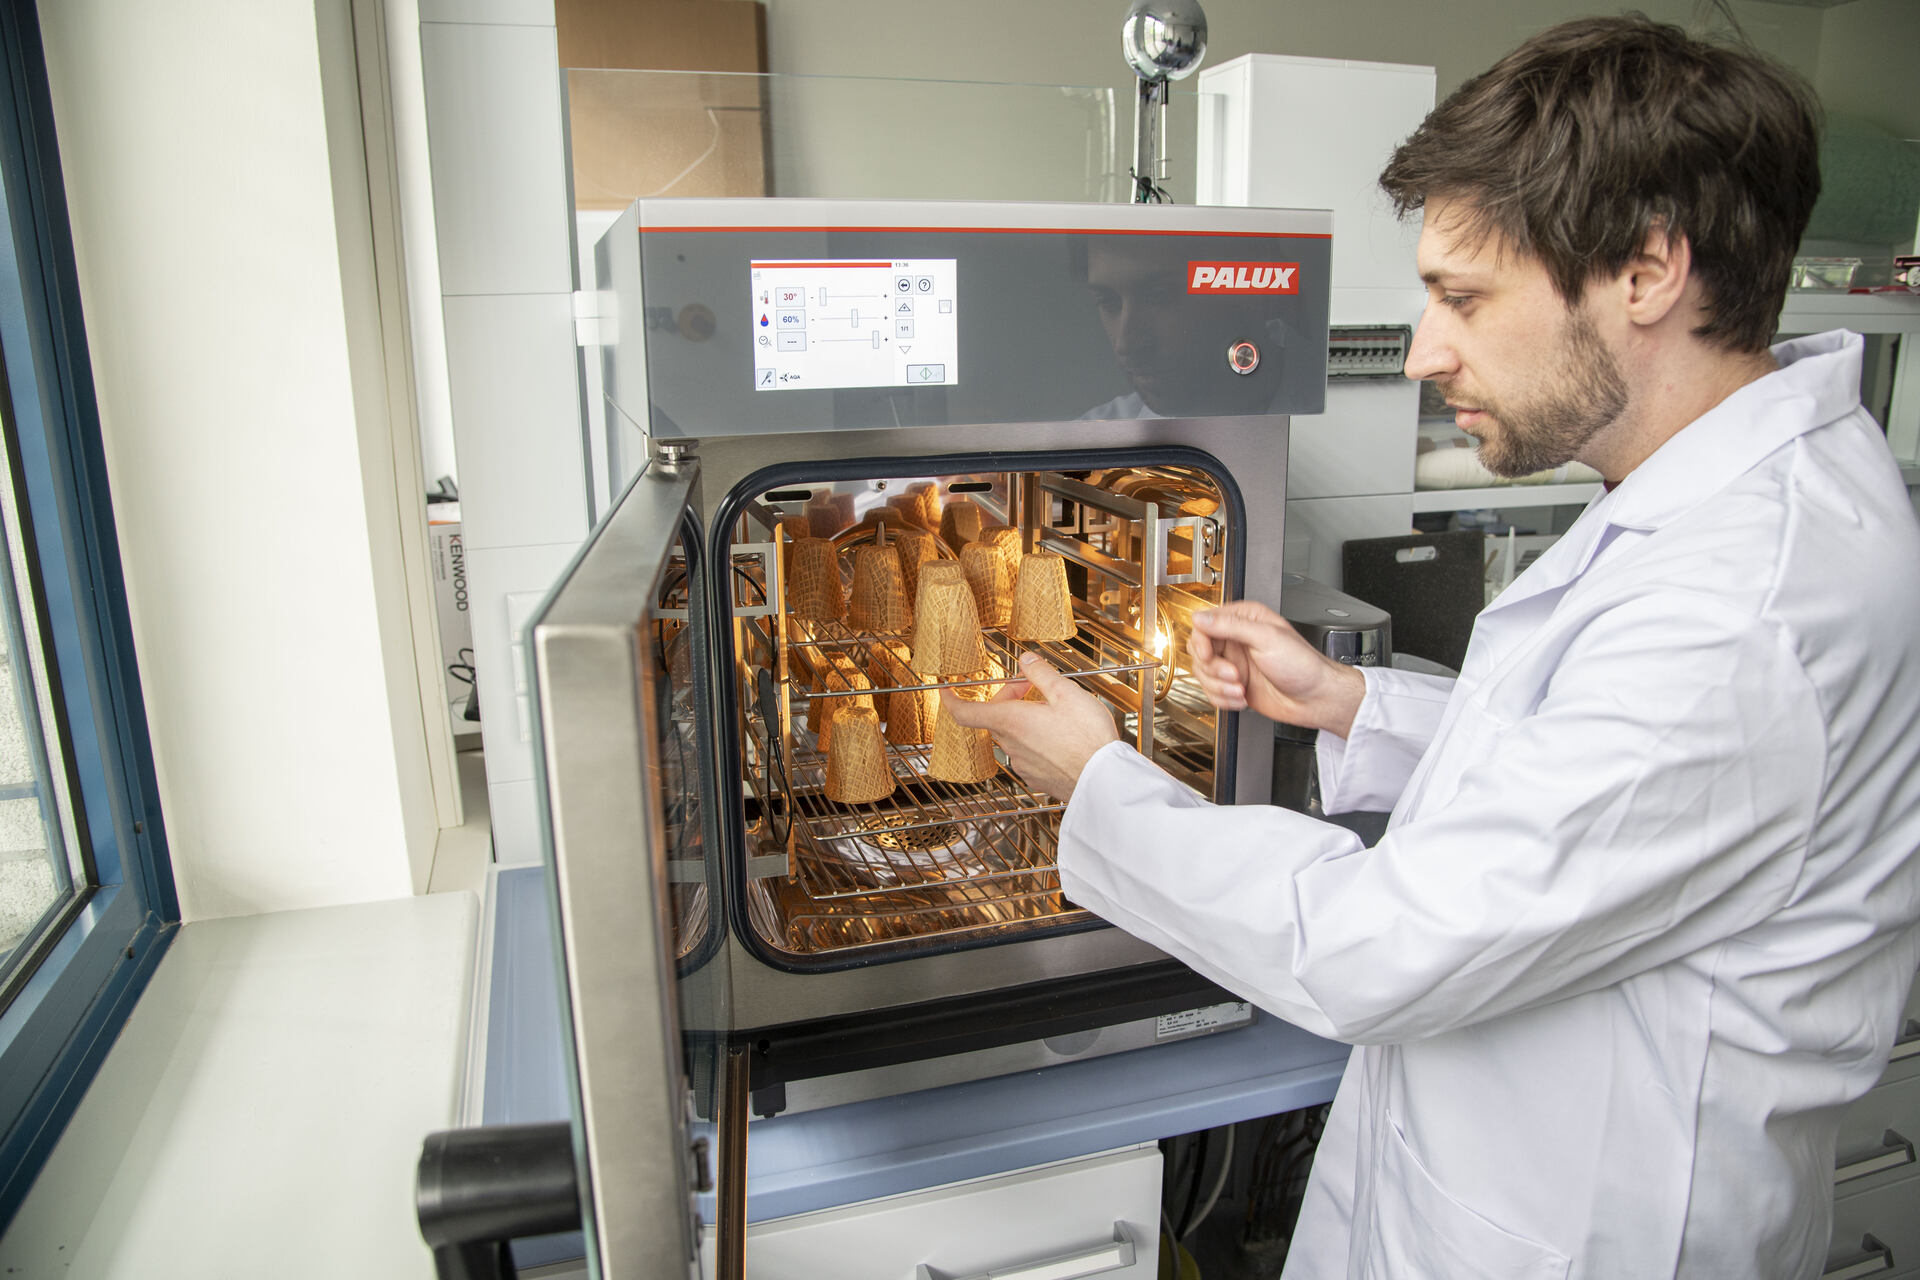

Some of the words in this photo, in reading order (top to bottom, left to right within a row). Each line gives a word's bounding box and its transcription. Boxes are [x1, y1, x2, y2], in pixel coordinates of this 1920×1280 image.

[1192, 266, 1296, 289] PALUX
[783, 292, 798, 301] 30°
[782, 316, 800, 324] 60%
[449, 534, 469, 612] KENWOOD
